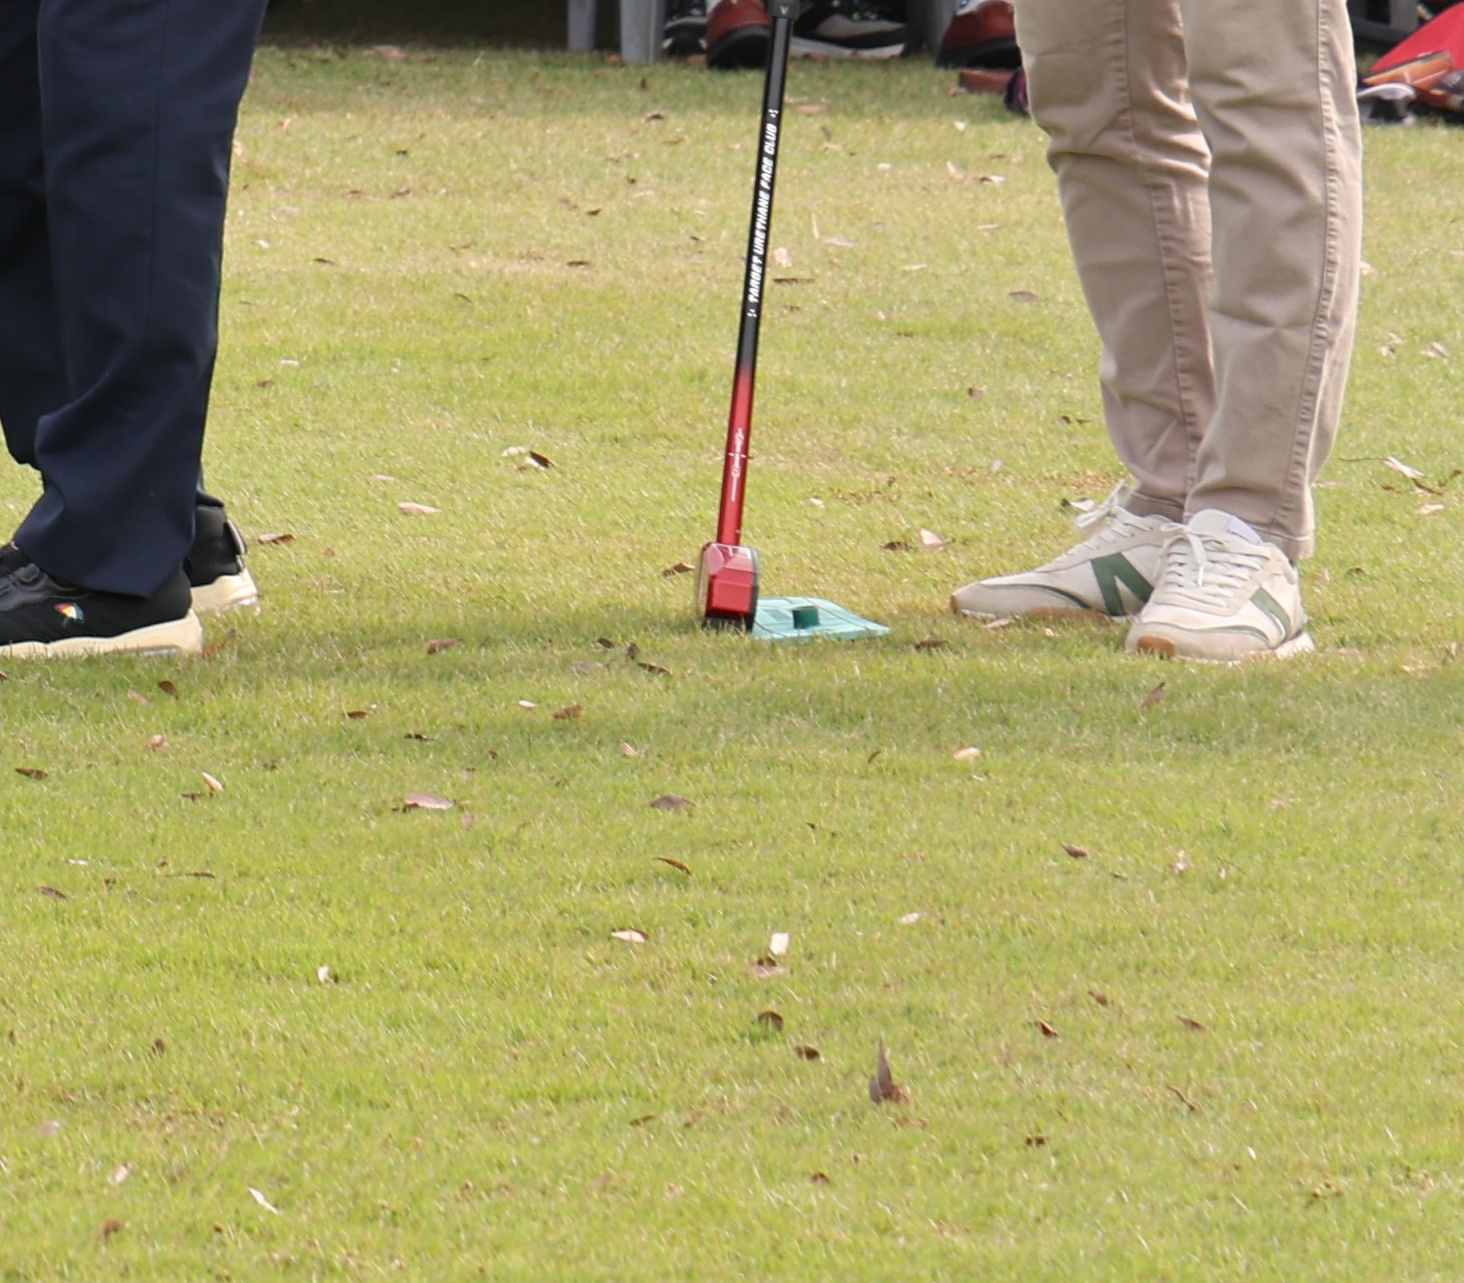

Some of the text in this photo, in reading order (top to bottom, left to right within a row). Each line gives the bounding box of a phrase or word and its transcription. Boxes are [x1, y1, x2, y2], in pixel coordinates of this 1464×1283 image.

[763, 122, 778, 156] CLUB
[759, 156, 775, 190] FACE
[752, 190, 771, 256] URETHANE
